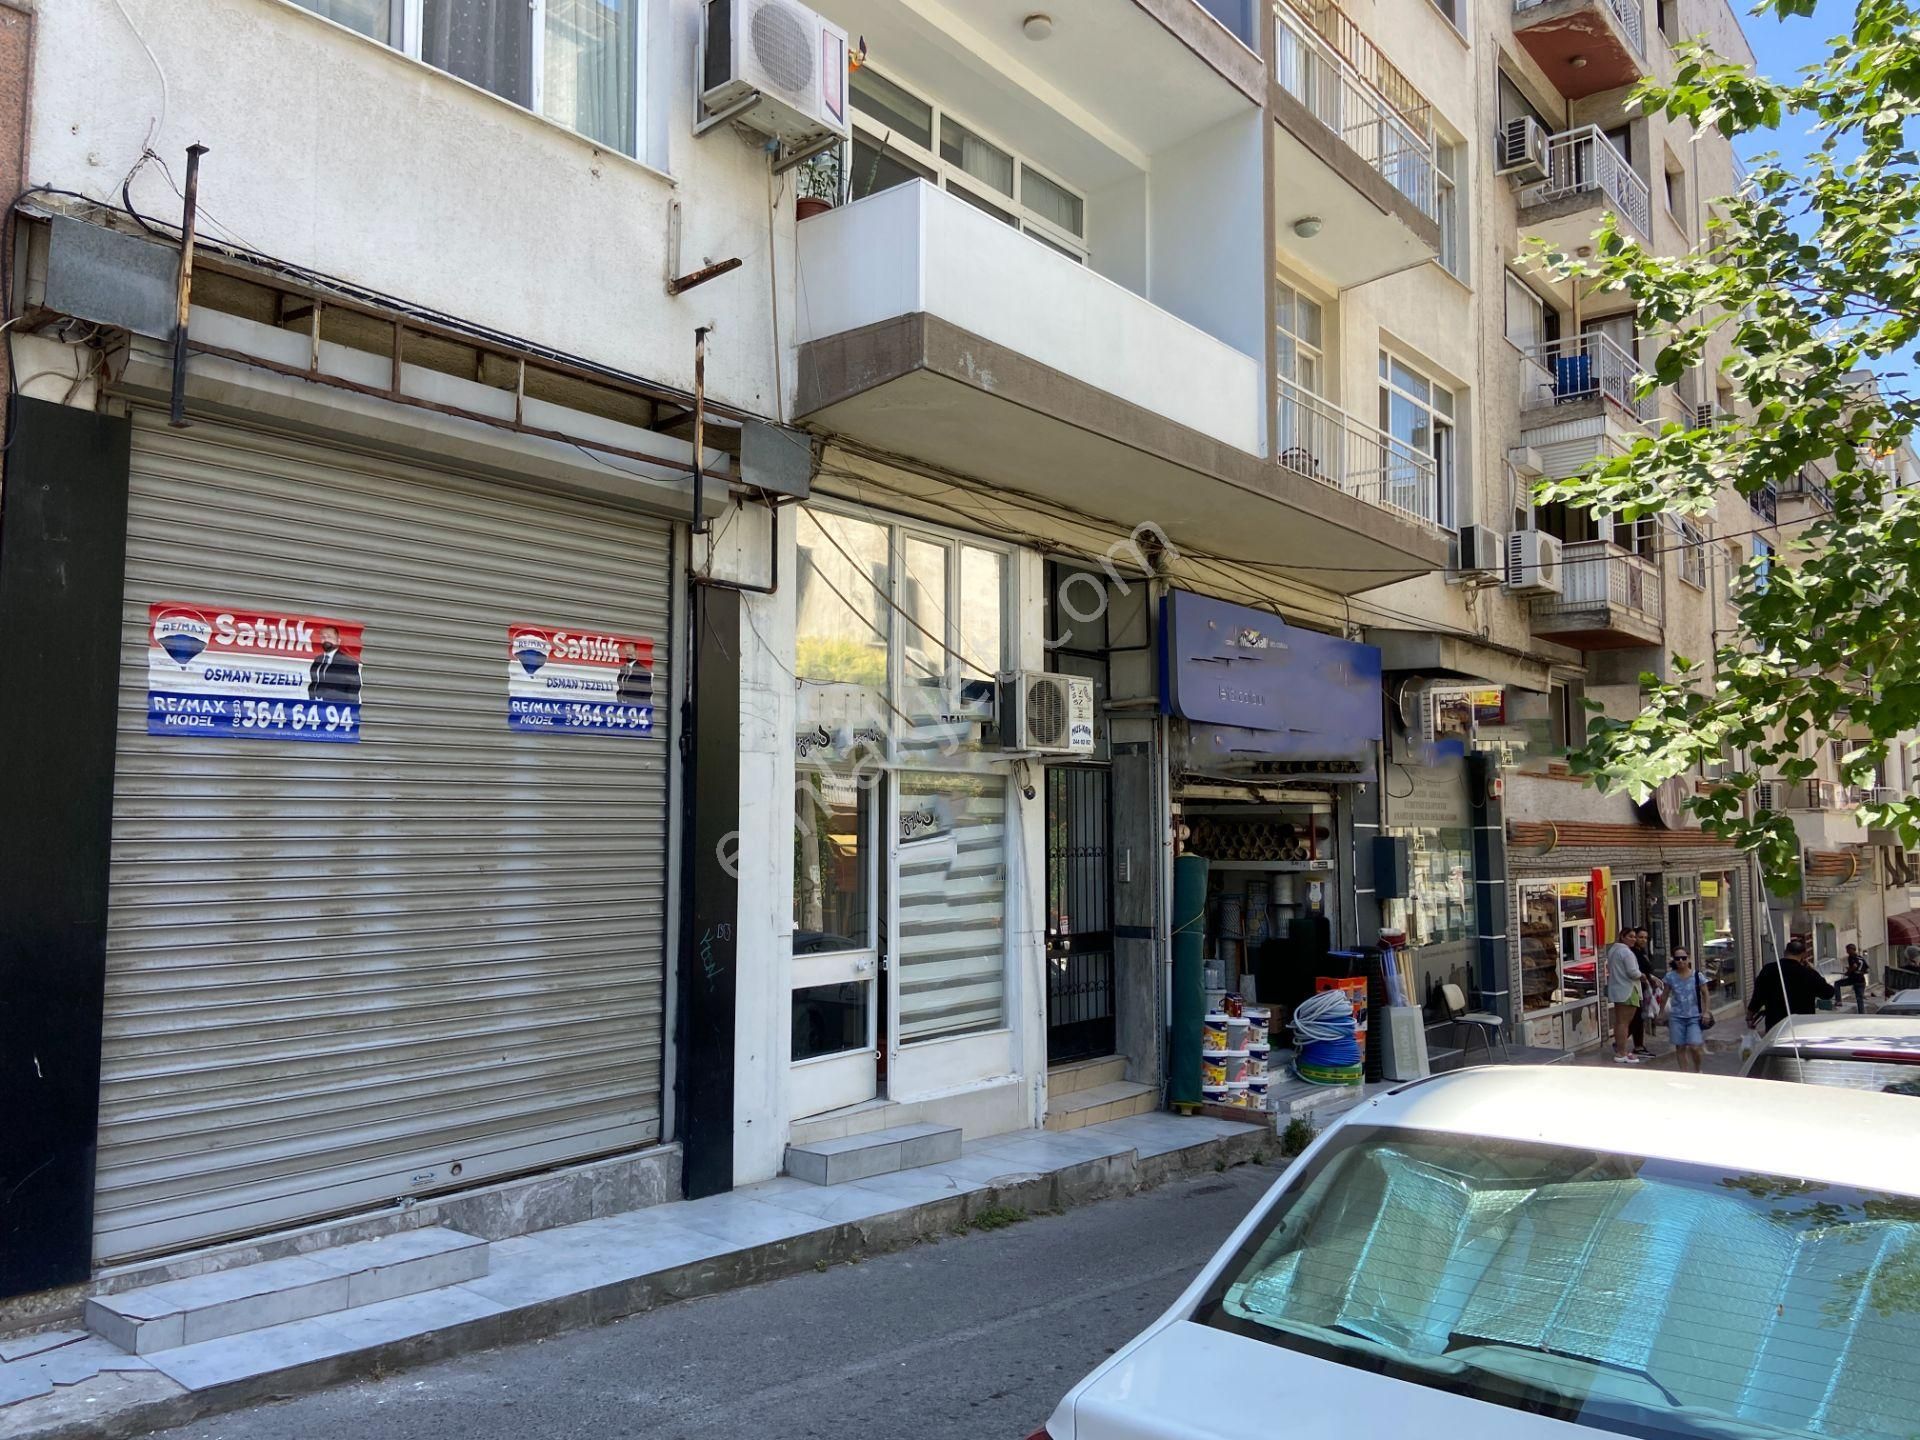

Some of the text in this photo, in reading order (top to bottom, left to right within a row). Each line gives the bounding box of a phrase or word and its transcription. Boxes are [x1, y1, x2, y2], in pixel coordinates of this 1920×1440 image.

[163, 622, 205, 635] RE/MAX
[215, 613, 314, 652] Satılık
[552, 632, 620, 663] Satılık
[204, 668, 251, 684] OSMAN
[546, 677, 578, 690] OSMAN
[153, 696, 227, 714] RE/MAX
[512, 700, 562, 715] RE/MAX
[165, 714, 215, 728] MODEL
[242, 700, 287, 729] 364
[292, 703, 322, 731] 64
[325, 705, 354, 732] 94
[520, 715, 554, 726] MODEL
[572, 703, 603, 728] 364
[605, 705, 627, 729] 64
[628, 707, 649, 729] 94
